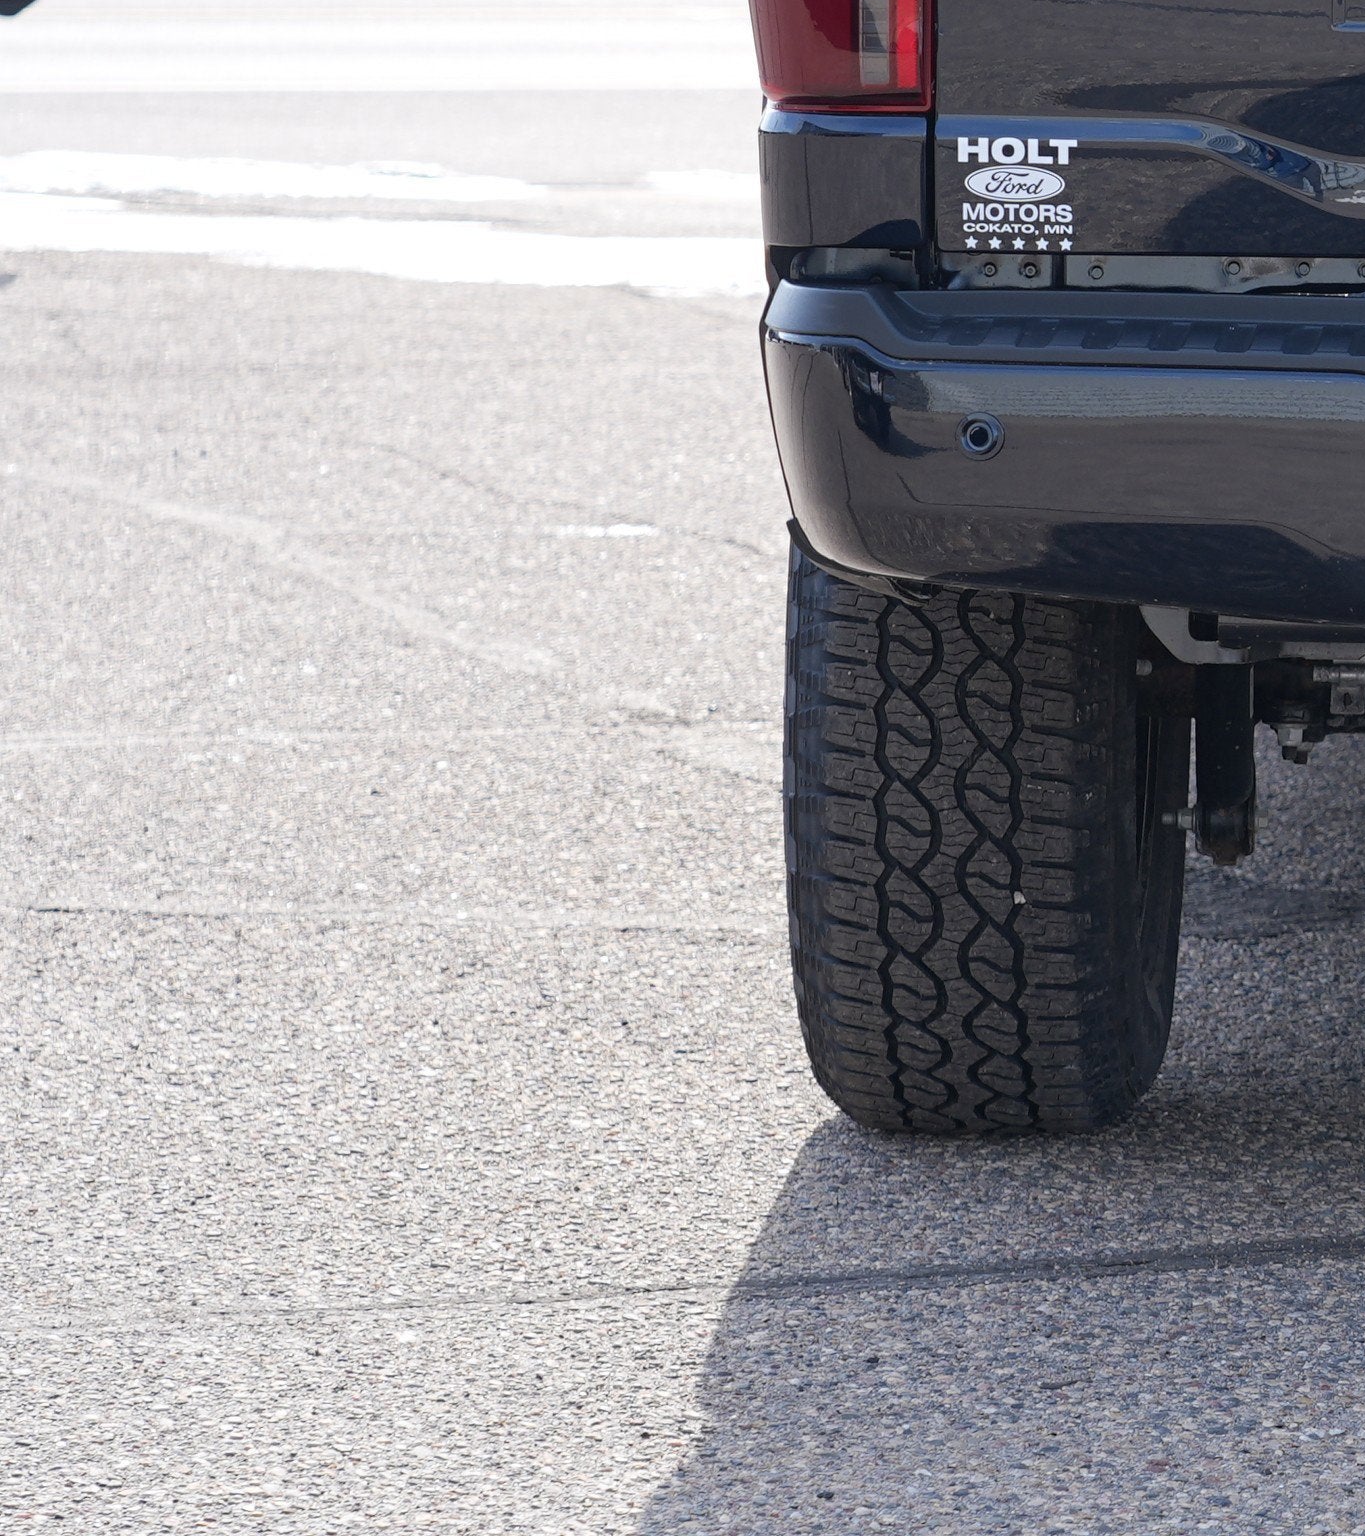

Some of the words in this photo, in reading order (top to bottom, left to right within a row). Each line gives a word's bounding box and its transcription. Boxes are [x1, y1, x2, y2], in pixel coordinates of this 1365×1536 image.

[957, 136, 1078, 165] HOLT
[985, 170, 1044, 195] Ford
[962, 202, 1074, 223] MOTORS
[962, 222, 1039, 236] COKATO,
[1044, 224, 1073, 235] MN
